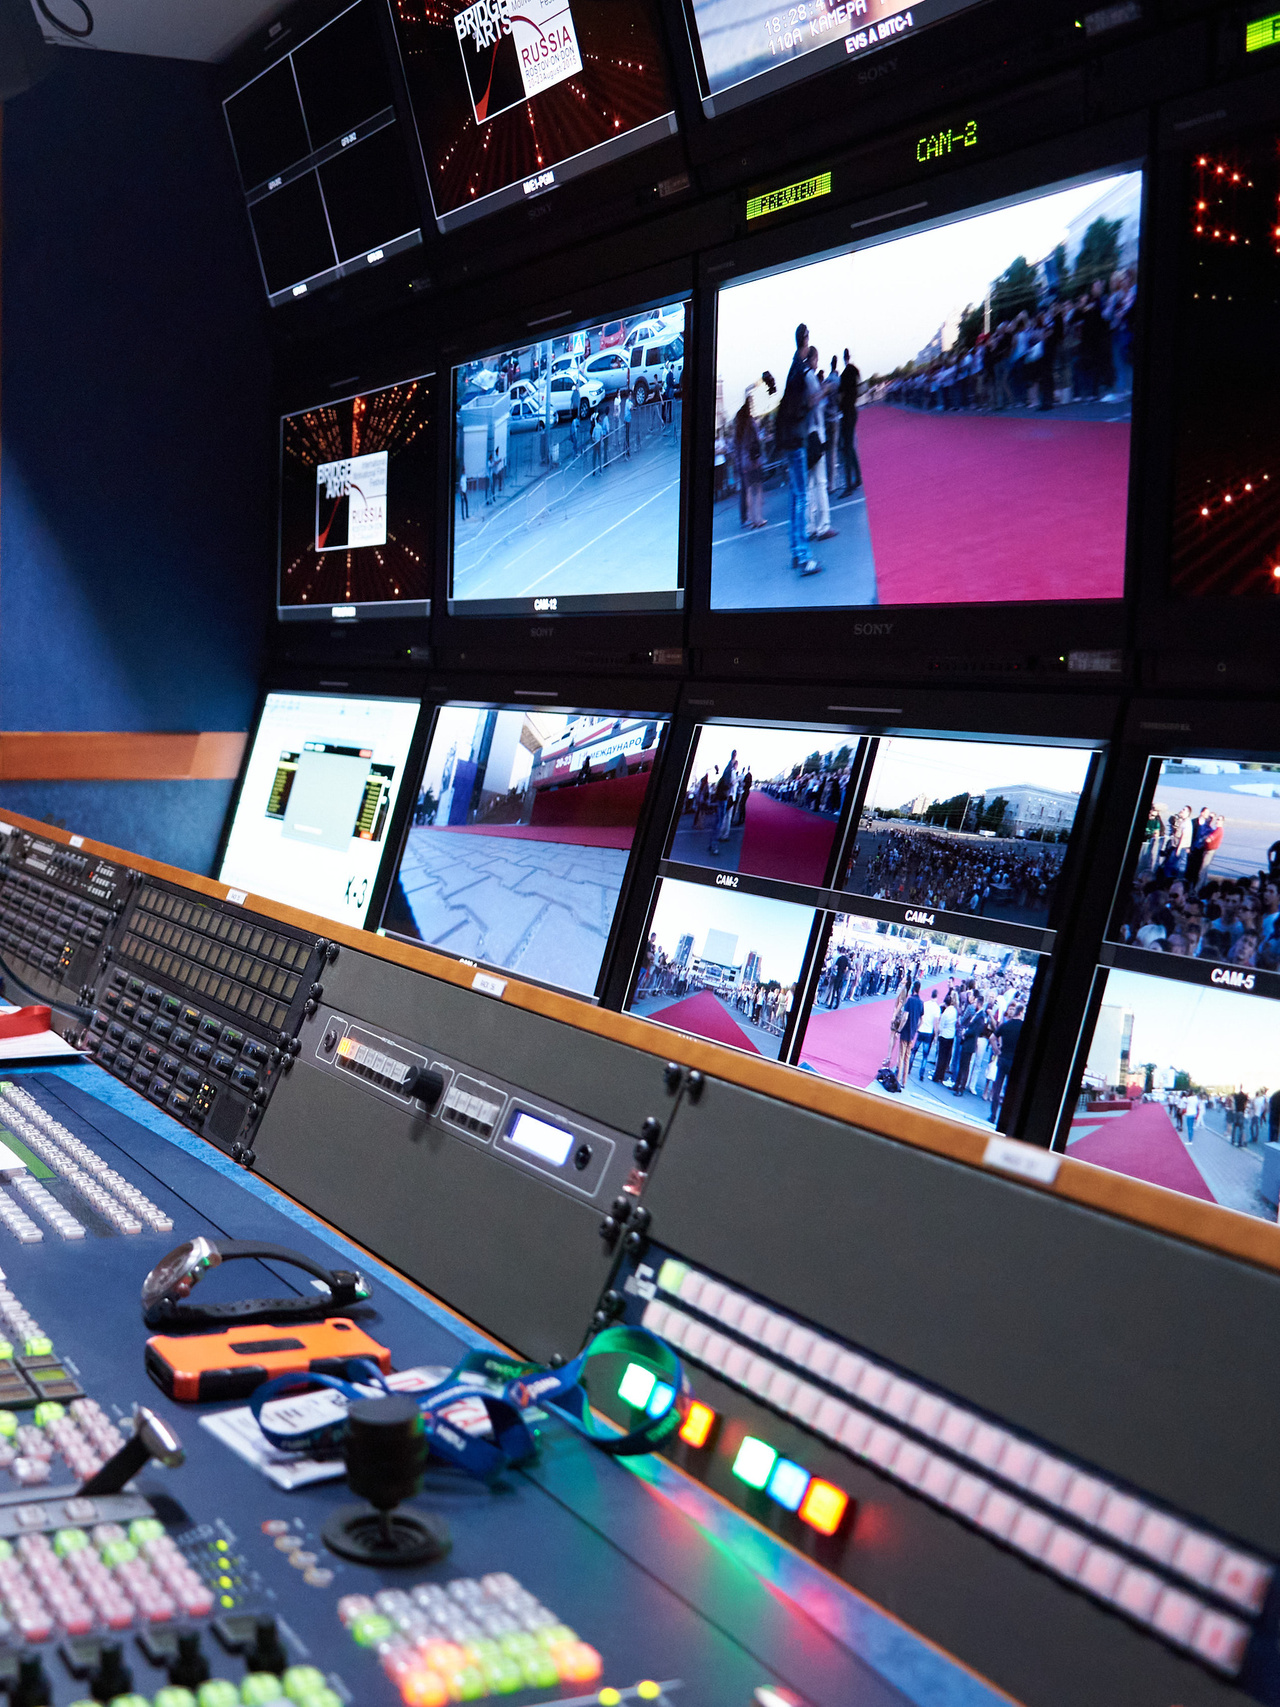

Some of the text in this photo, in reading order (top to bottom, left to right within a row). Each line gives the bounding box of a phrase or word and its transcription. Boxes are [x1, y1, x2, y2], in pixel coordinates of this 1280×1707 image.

[456, 0, 509, 41] BRIDGE
[475, 13, 513, 53] ARTS
[845, 12, 914, 54] EVS A BITC-1
[521, 25, 572, 68] RUSSIA
[916, 120, 978, 163] CAM-2
[761, 179, 819, 213] PREVIEW
[853, 623, 894, 635] SONY
[715, 873, 739, 888] CAM-2
[904, 909, 936, 926] CAM-4
[1210, 968, 1256, 990] CAM-5
